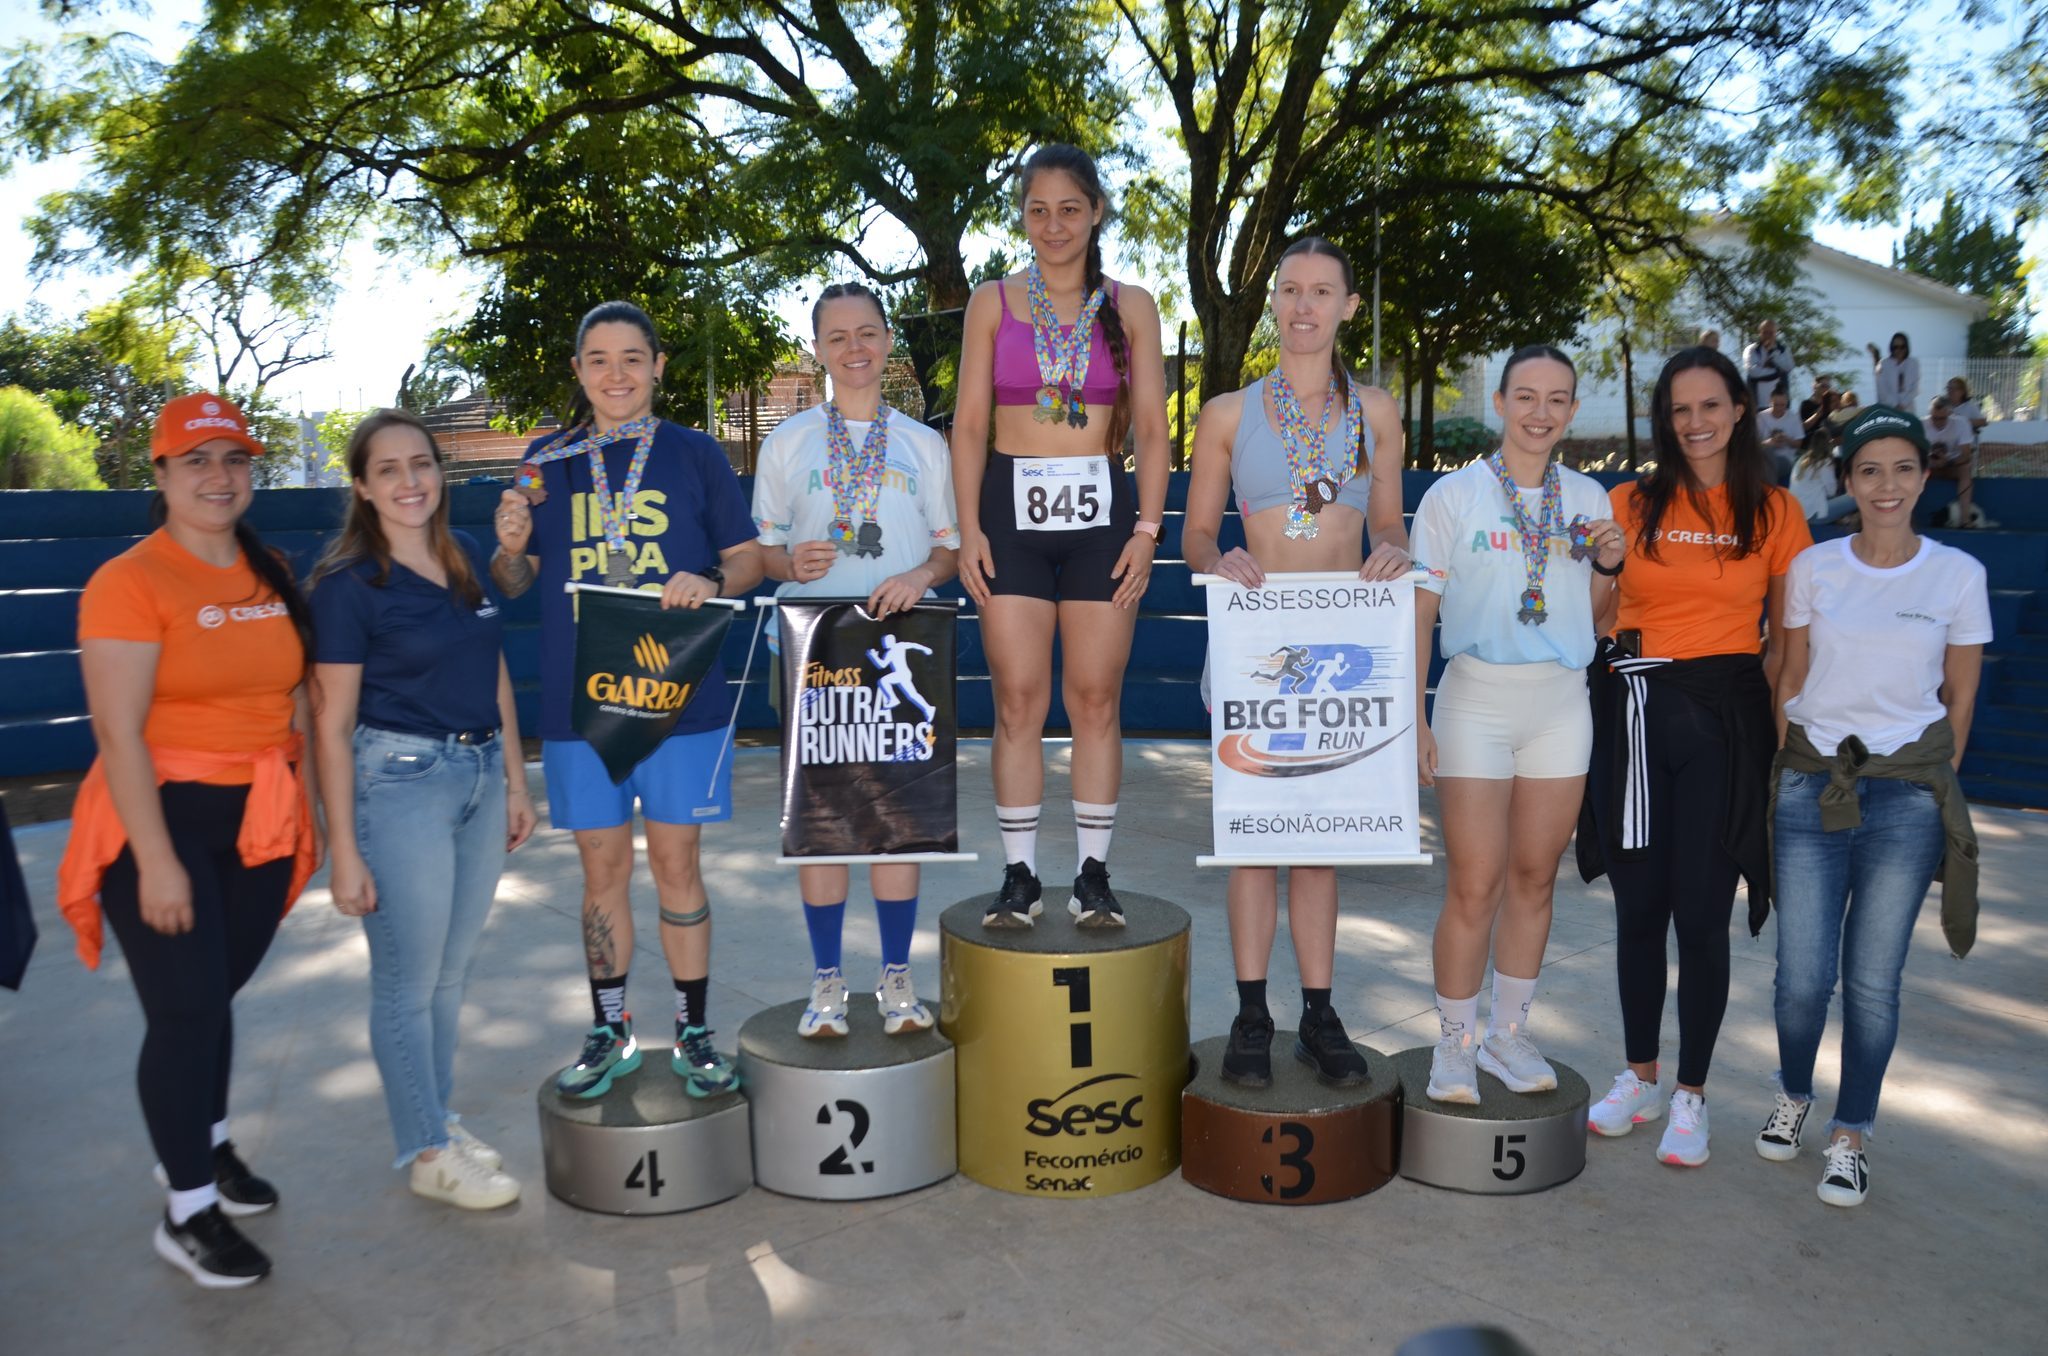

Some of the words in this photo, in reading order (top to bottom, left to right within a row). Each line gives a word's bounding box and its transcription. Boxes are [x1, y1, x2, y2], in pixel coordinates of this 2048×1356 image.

[1027, 484, 1099, 524] 845
[1227, 587, 1396, 611] ASSESSORIA
[586, 672, 691, 710] GARRA
[802, 661, 862, 687] Fitness
[800, 685, 894, 726] DUTRA
[1223, 698, 1287, 731] BIG
[1298, 696, 1394, 729] FORT
[800, 721, 934, 765] RUNNERS
[1317, 731, 1366, 750] RUN
[1229, 813, 1403, 834] #ÉSÓNÃOPARAR
[1052, 966, 1092, 1068] 1
[1025, 1094, 1143, 1137] Sesc
[816, 1098, 875, 1175] 2
[625, 1150, 665, 1197] 4
[1025, 1145, 1143, 1169] Fecomércio
[1261, 1121, 1316, 1200] 3
[1492, 1134, 1527, 1181] 5
[1026, 1174, 1092, 1191] Senac
